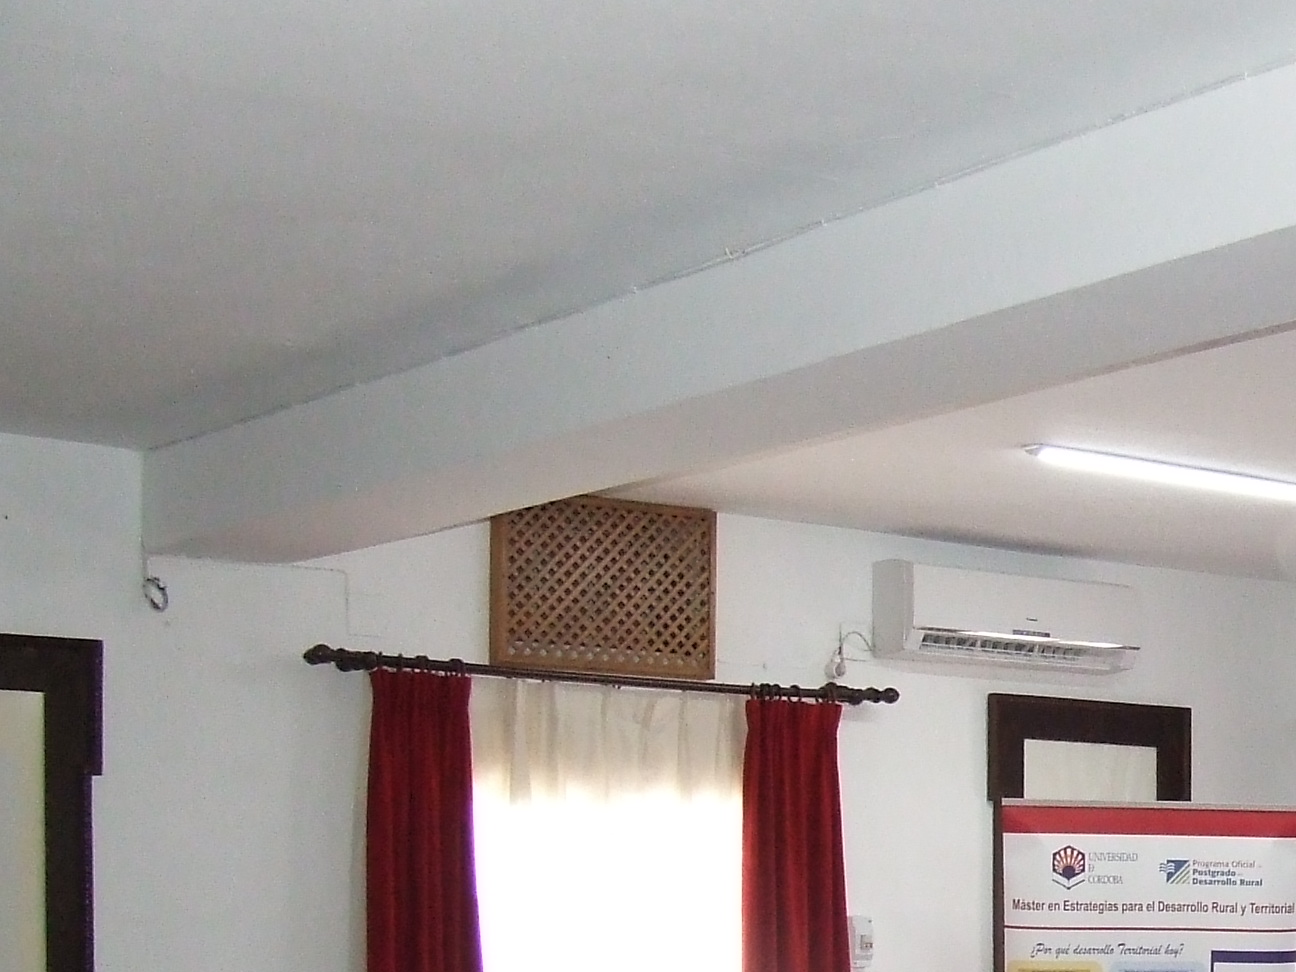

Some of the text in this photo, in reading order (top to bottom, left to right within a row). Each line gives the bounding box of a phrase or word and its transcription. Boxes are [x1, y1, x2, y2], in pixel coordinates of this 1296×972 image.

[1193, 860, 1256, 869] Programa Oficial
[1192, 868, 1236, 878] Postgrado
[1192, 877, 1263, 887] Desarrollo Rural
[1012, 898, 1295, 916] Máster en Estrategias para el Desarrollo Rural y Territorial
[1030, 943, 1185, 958] ¿Por qué desarrollo Territorial hoy?
